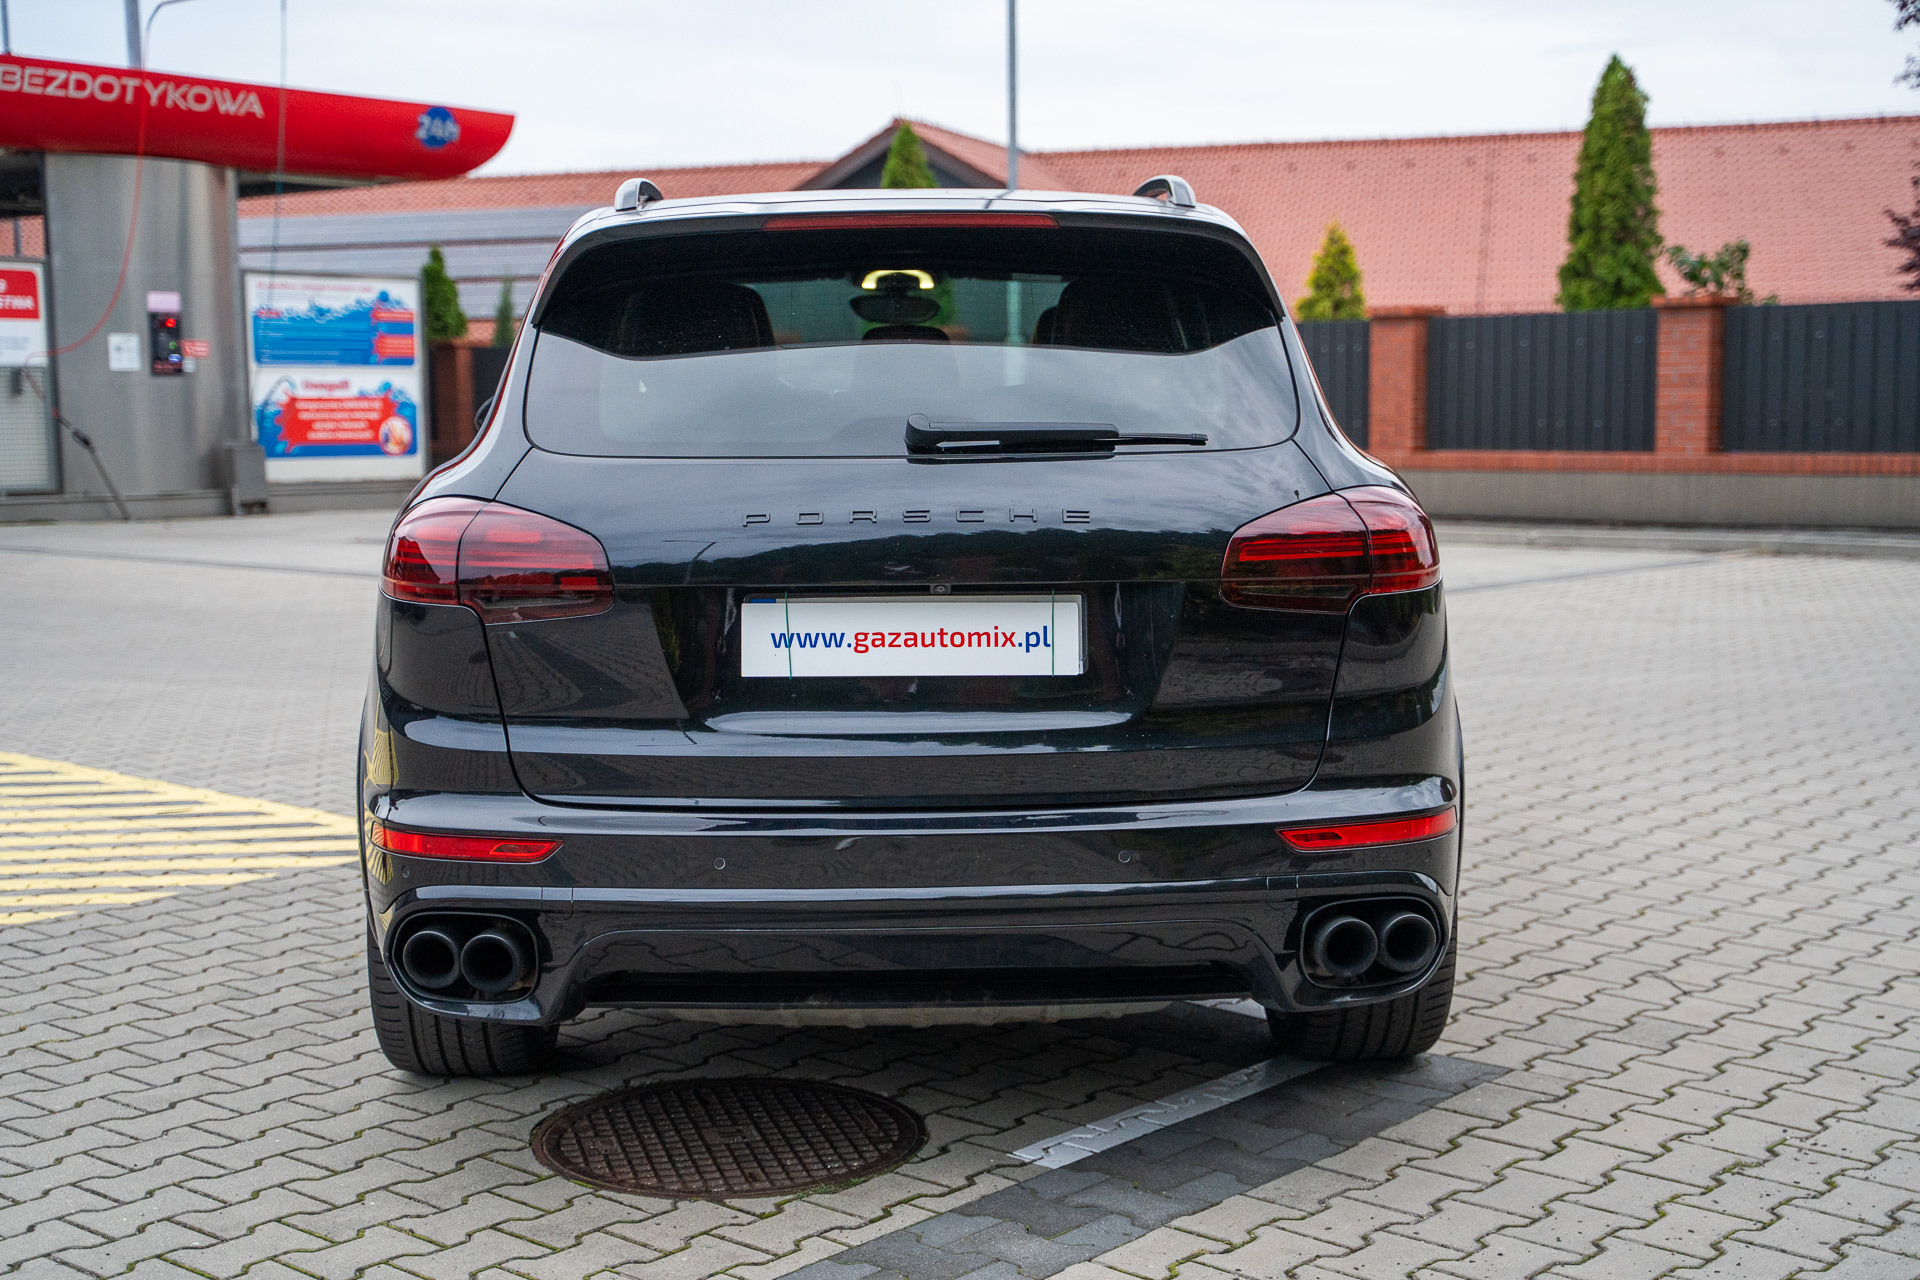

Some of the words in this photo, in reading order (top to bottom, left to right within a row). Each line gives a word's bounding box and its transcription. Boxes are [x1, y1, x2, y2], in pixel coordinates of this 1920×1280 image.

[0, 63, 265, 119] BEZDOTYKOWA
[742, 508, 1091, 527] PORSCHE
[770, 625, 1051, 653] www.gazautomix.pl
